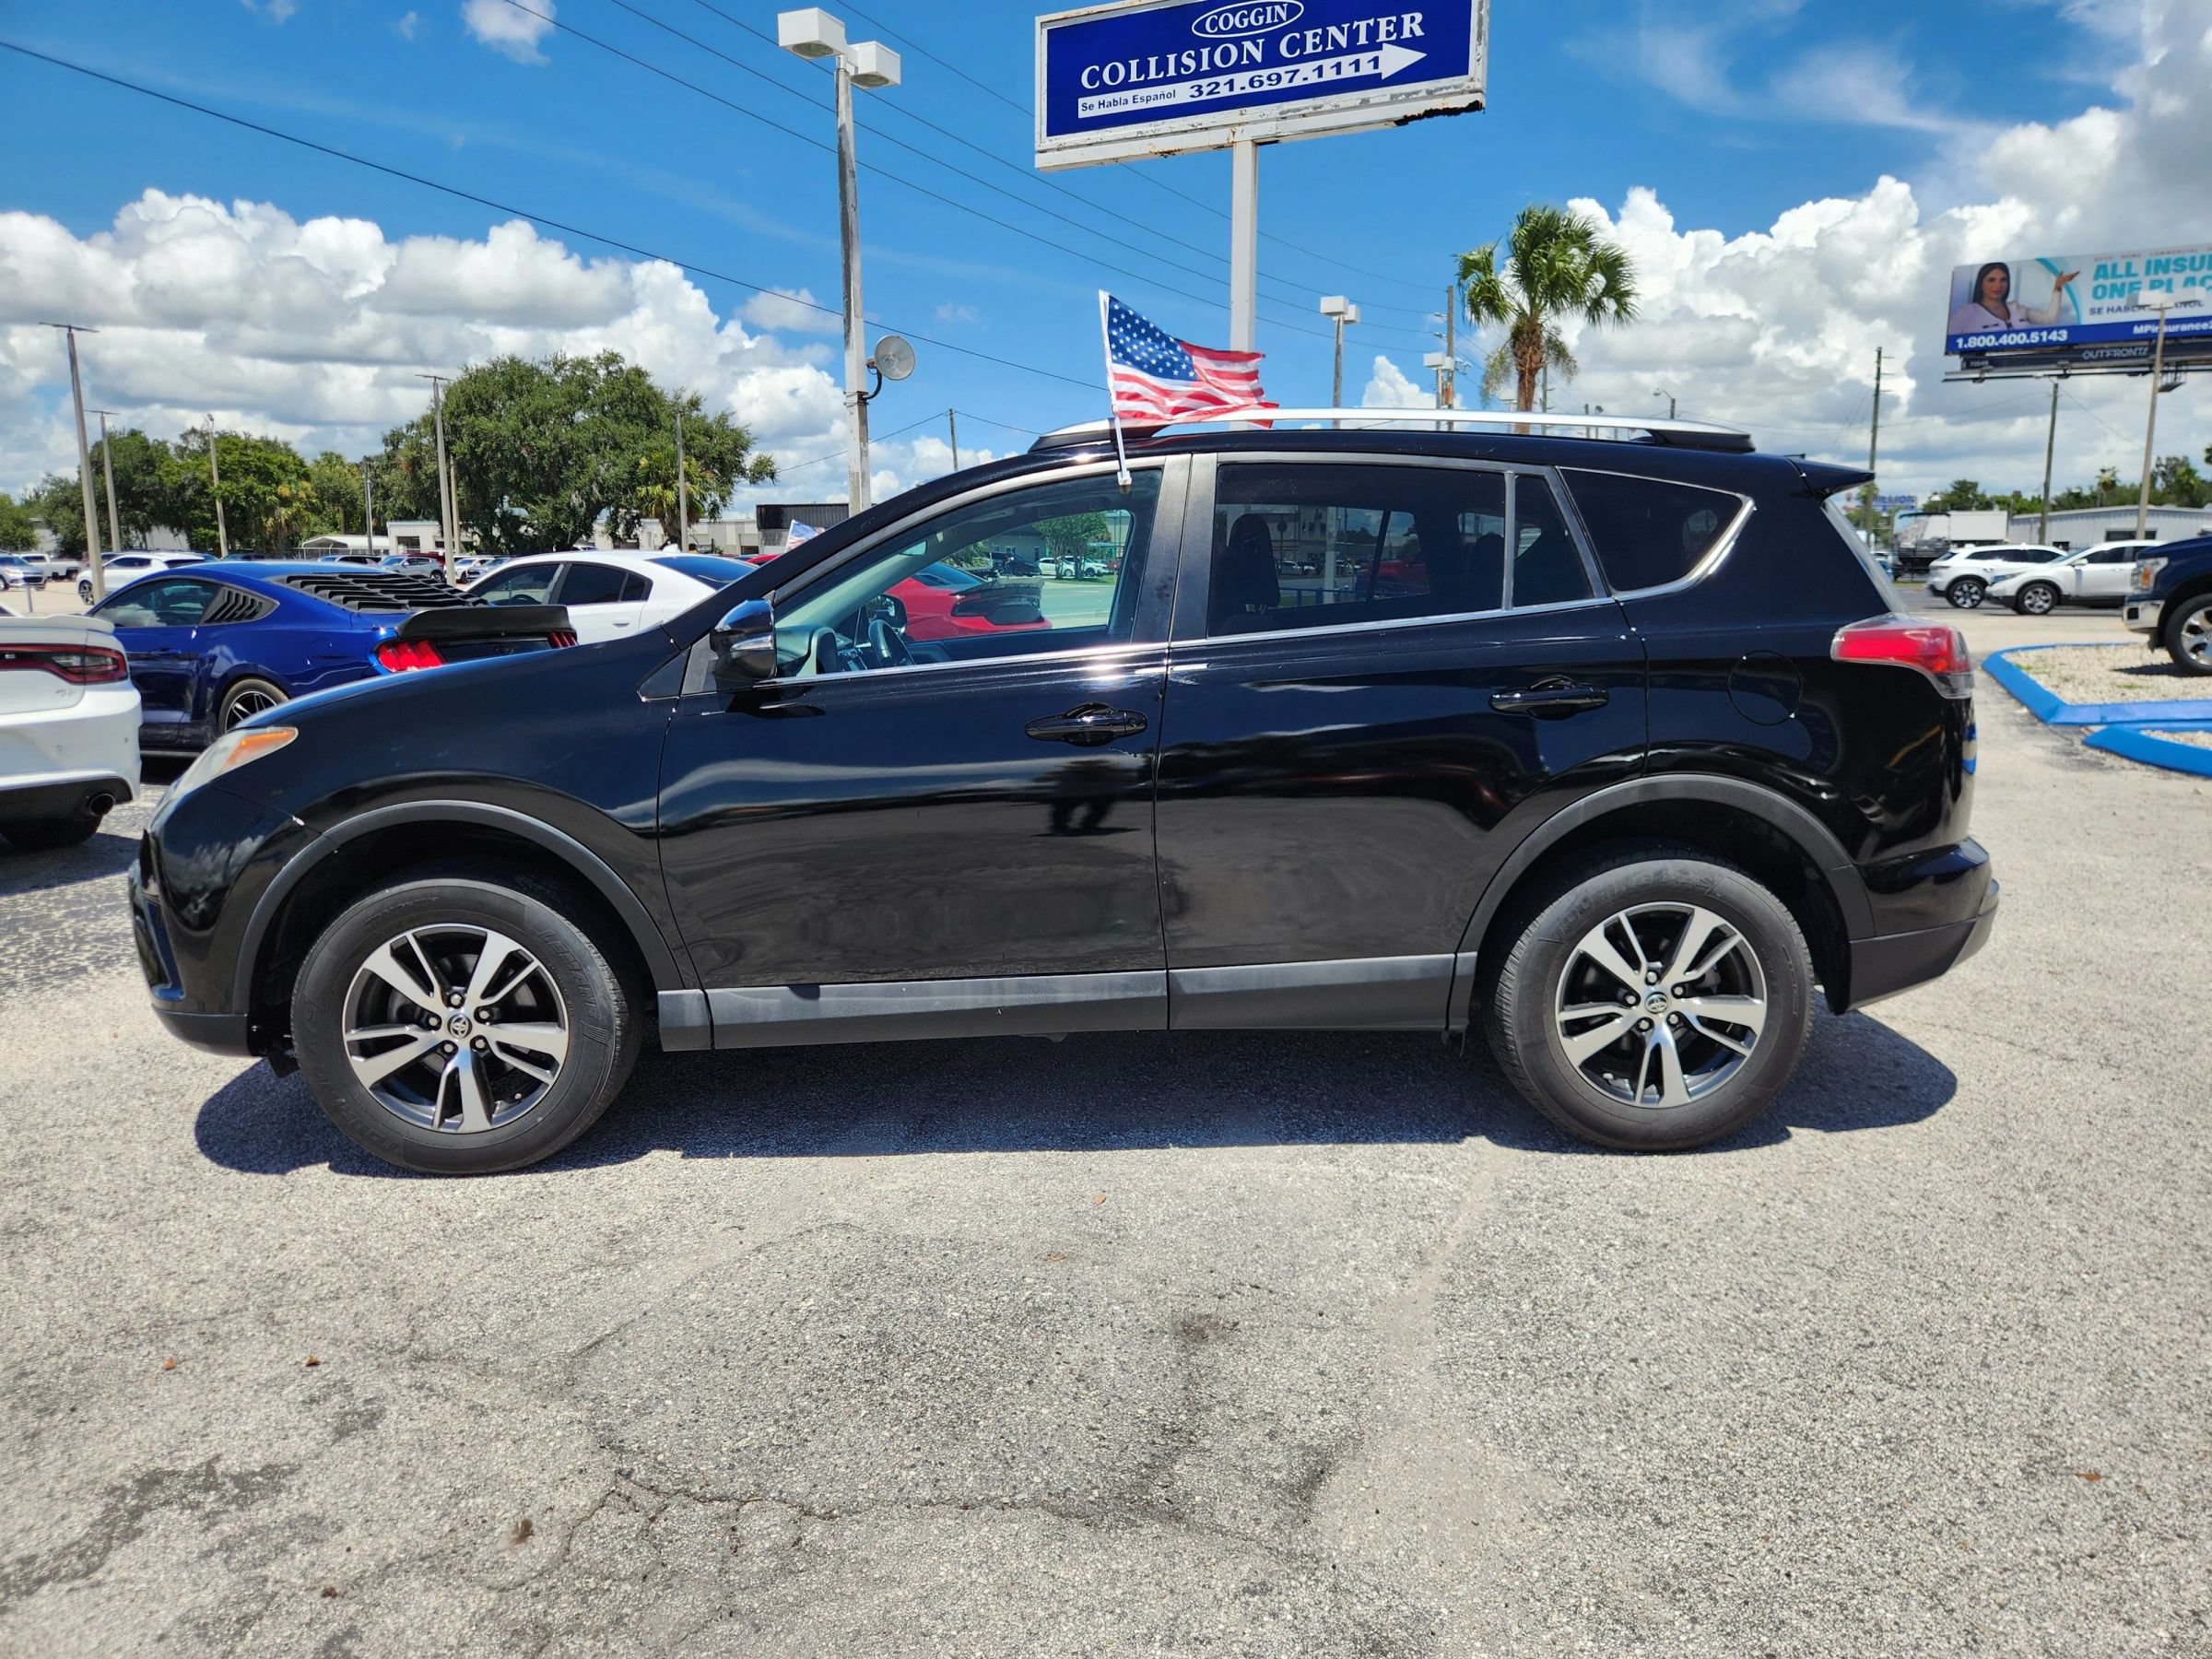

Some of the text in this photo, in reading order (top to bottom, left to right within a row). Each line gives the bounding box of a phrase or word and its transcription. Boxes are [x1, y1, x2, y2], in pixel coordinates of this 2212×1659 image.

[1205, 3, 1288, 33] COGGIN
[1080, 11, 1425, 89] COLLISION CENTER
[1189, 55, 1381, 99] 321.697.1111
[1081, 89, 1176, 112] Se Habla Español
[2093, 261, 2139, 281] ALL
[2088, 307, 2104, 316] SE
[1956, 328, 2068, 349] 1.800.400.5143
